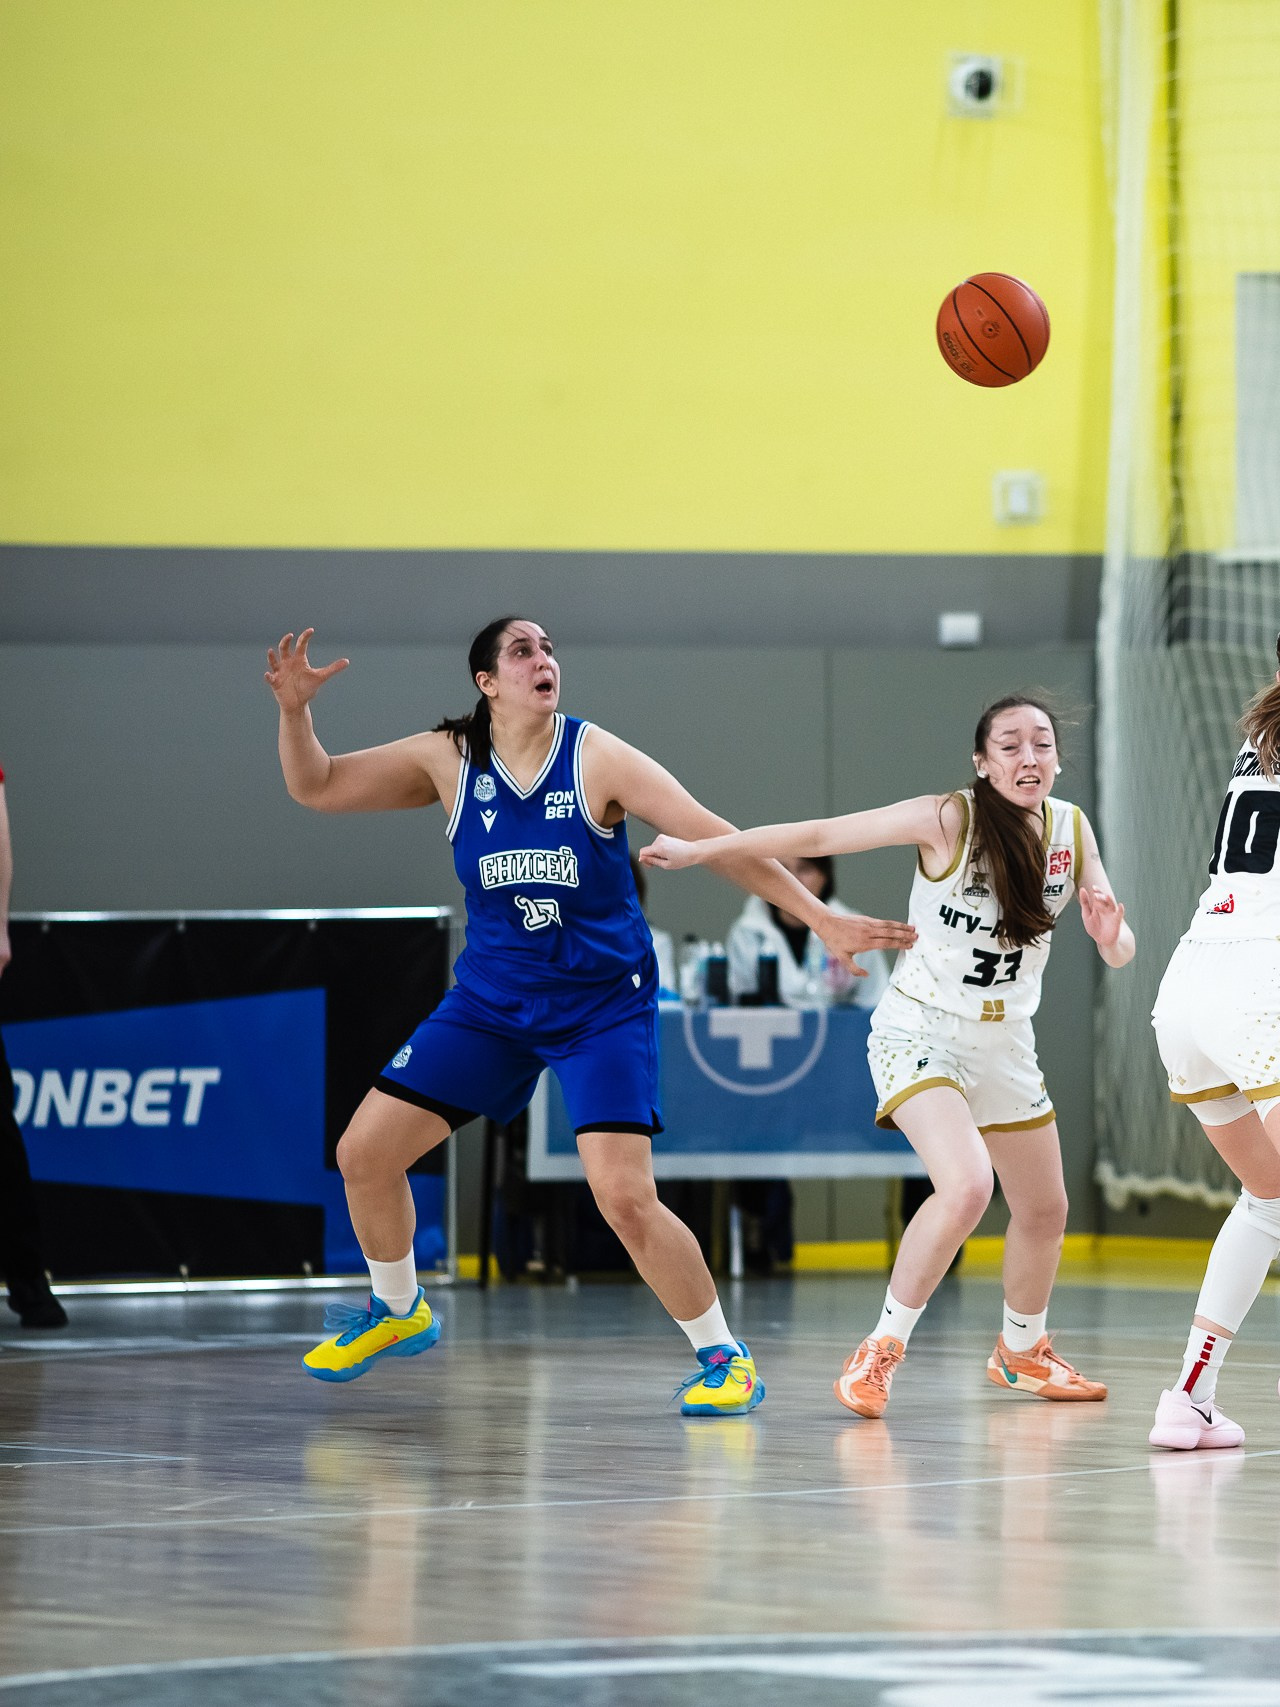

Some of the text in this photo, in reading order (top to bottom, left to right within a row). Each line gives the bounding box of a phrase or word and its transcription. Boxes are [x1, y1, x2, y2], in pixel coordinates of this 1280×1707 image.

[544, 790, 575, 806] FON
[545, 804, 576, 820] BET
[478, 845, 580, 891] ЕНИСЕЙ
[962, 947, 1024, 988] 33
[11, 1067, 222, 1128] ONBET
